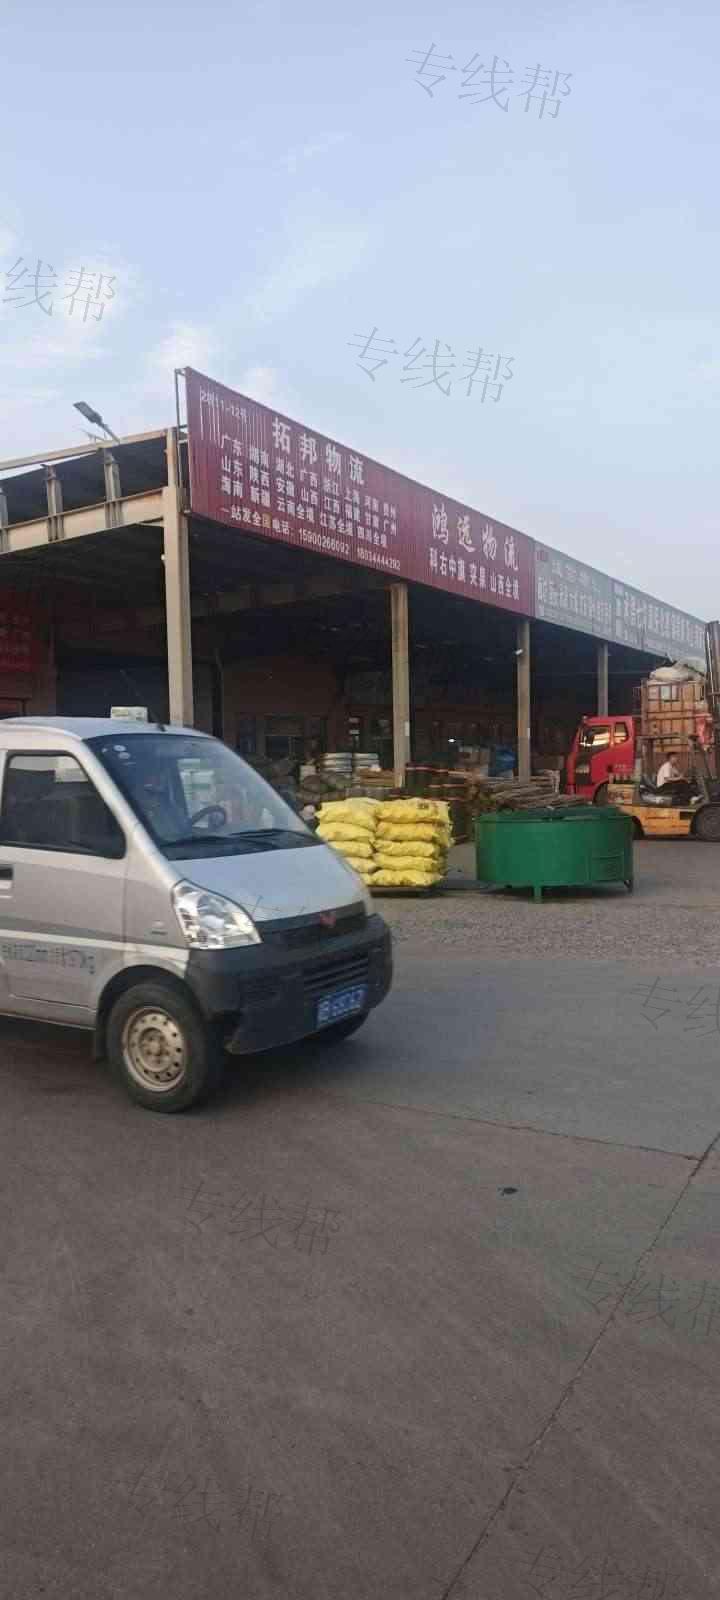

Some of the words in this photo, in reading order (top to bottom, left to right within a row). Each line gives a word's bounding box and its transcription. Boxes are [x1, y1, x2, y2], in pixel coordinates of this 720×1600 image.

[221, 434, 242, 456] 广东
[300, 468, 318, 488] 广西
[272, 417, 364, 486] 拓邦物流
[221, 455, 243, 477] 山东
[249, 465, 270, 488] 陕西
[275, 477, 295, 497] 安徽
[301, 487, 318, 505] 山西
[324, 495, 340, 514] 江西
[221, 475, 243, 498] 海南
[250, 485, 271, 508] 新疆
[276, 497, 315, 523] 云南全境
[490, 569, 519, 600] 山西全境
